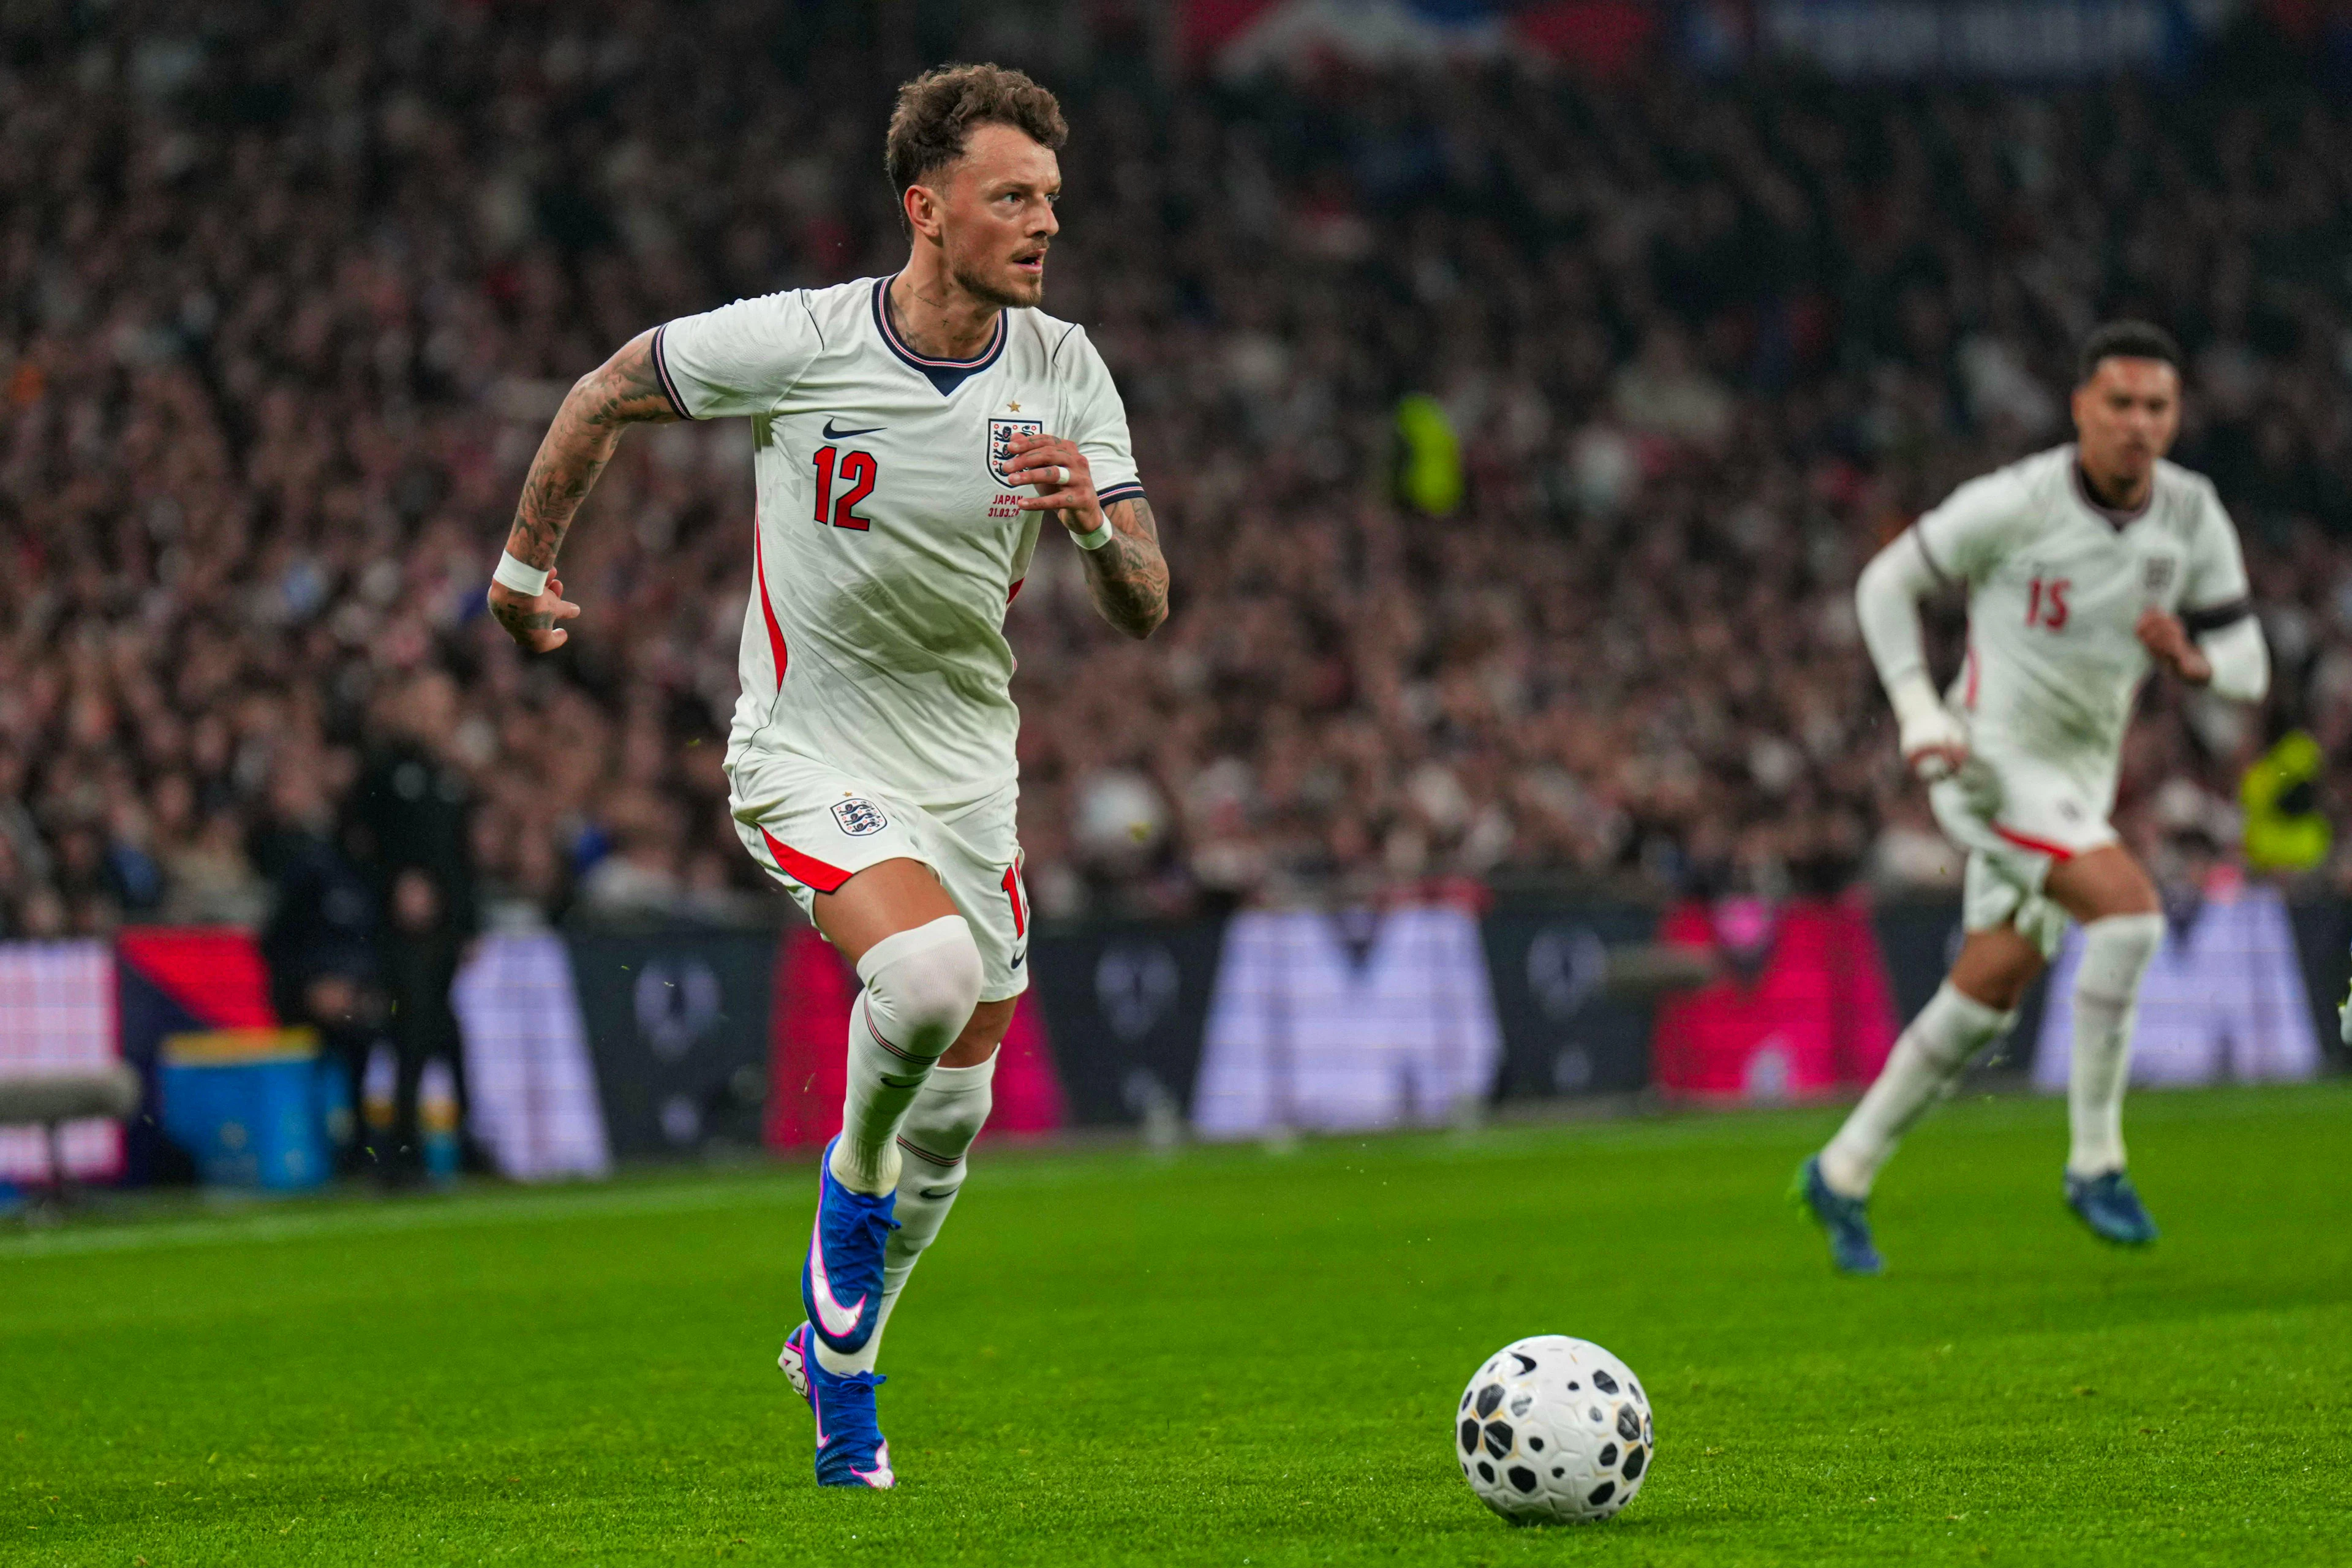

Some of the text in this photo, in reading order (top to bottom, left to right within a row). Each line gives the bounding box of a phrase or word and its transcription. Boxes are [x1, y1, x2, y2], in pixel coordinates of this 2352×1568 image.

[813, 445, 878, 532] 12
[988, 507, 1020, 518] 31.03.26
[2026, 575, 2073, 634] 15
